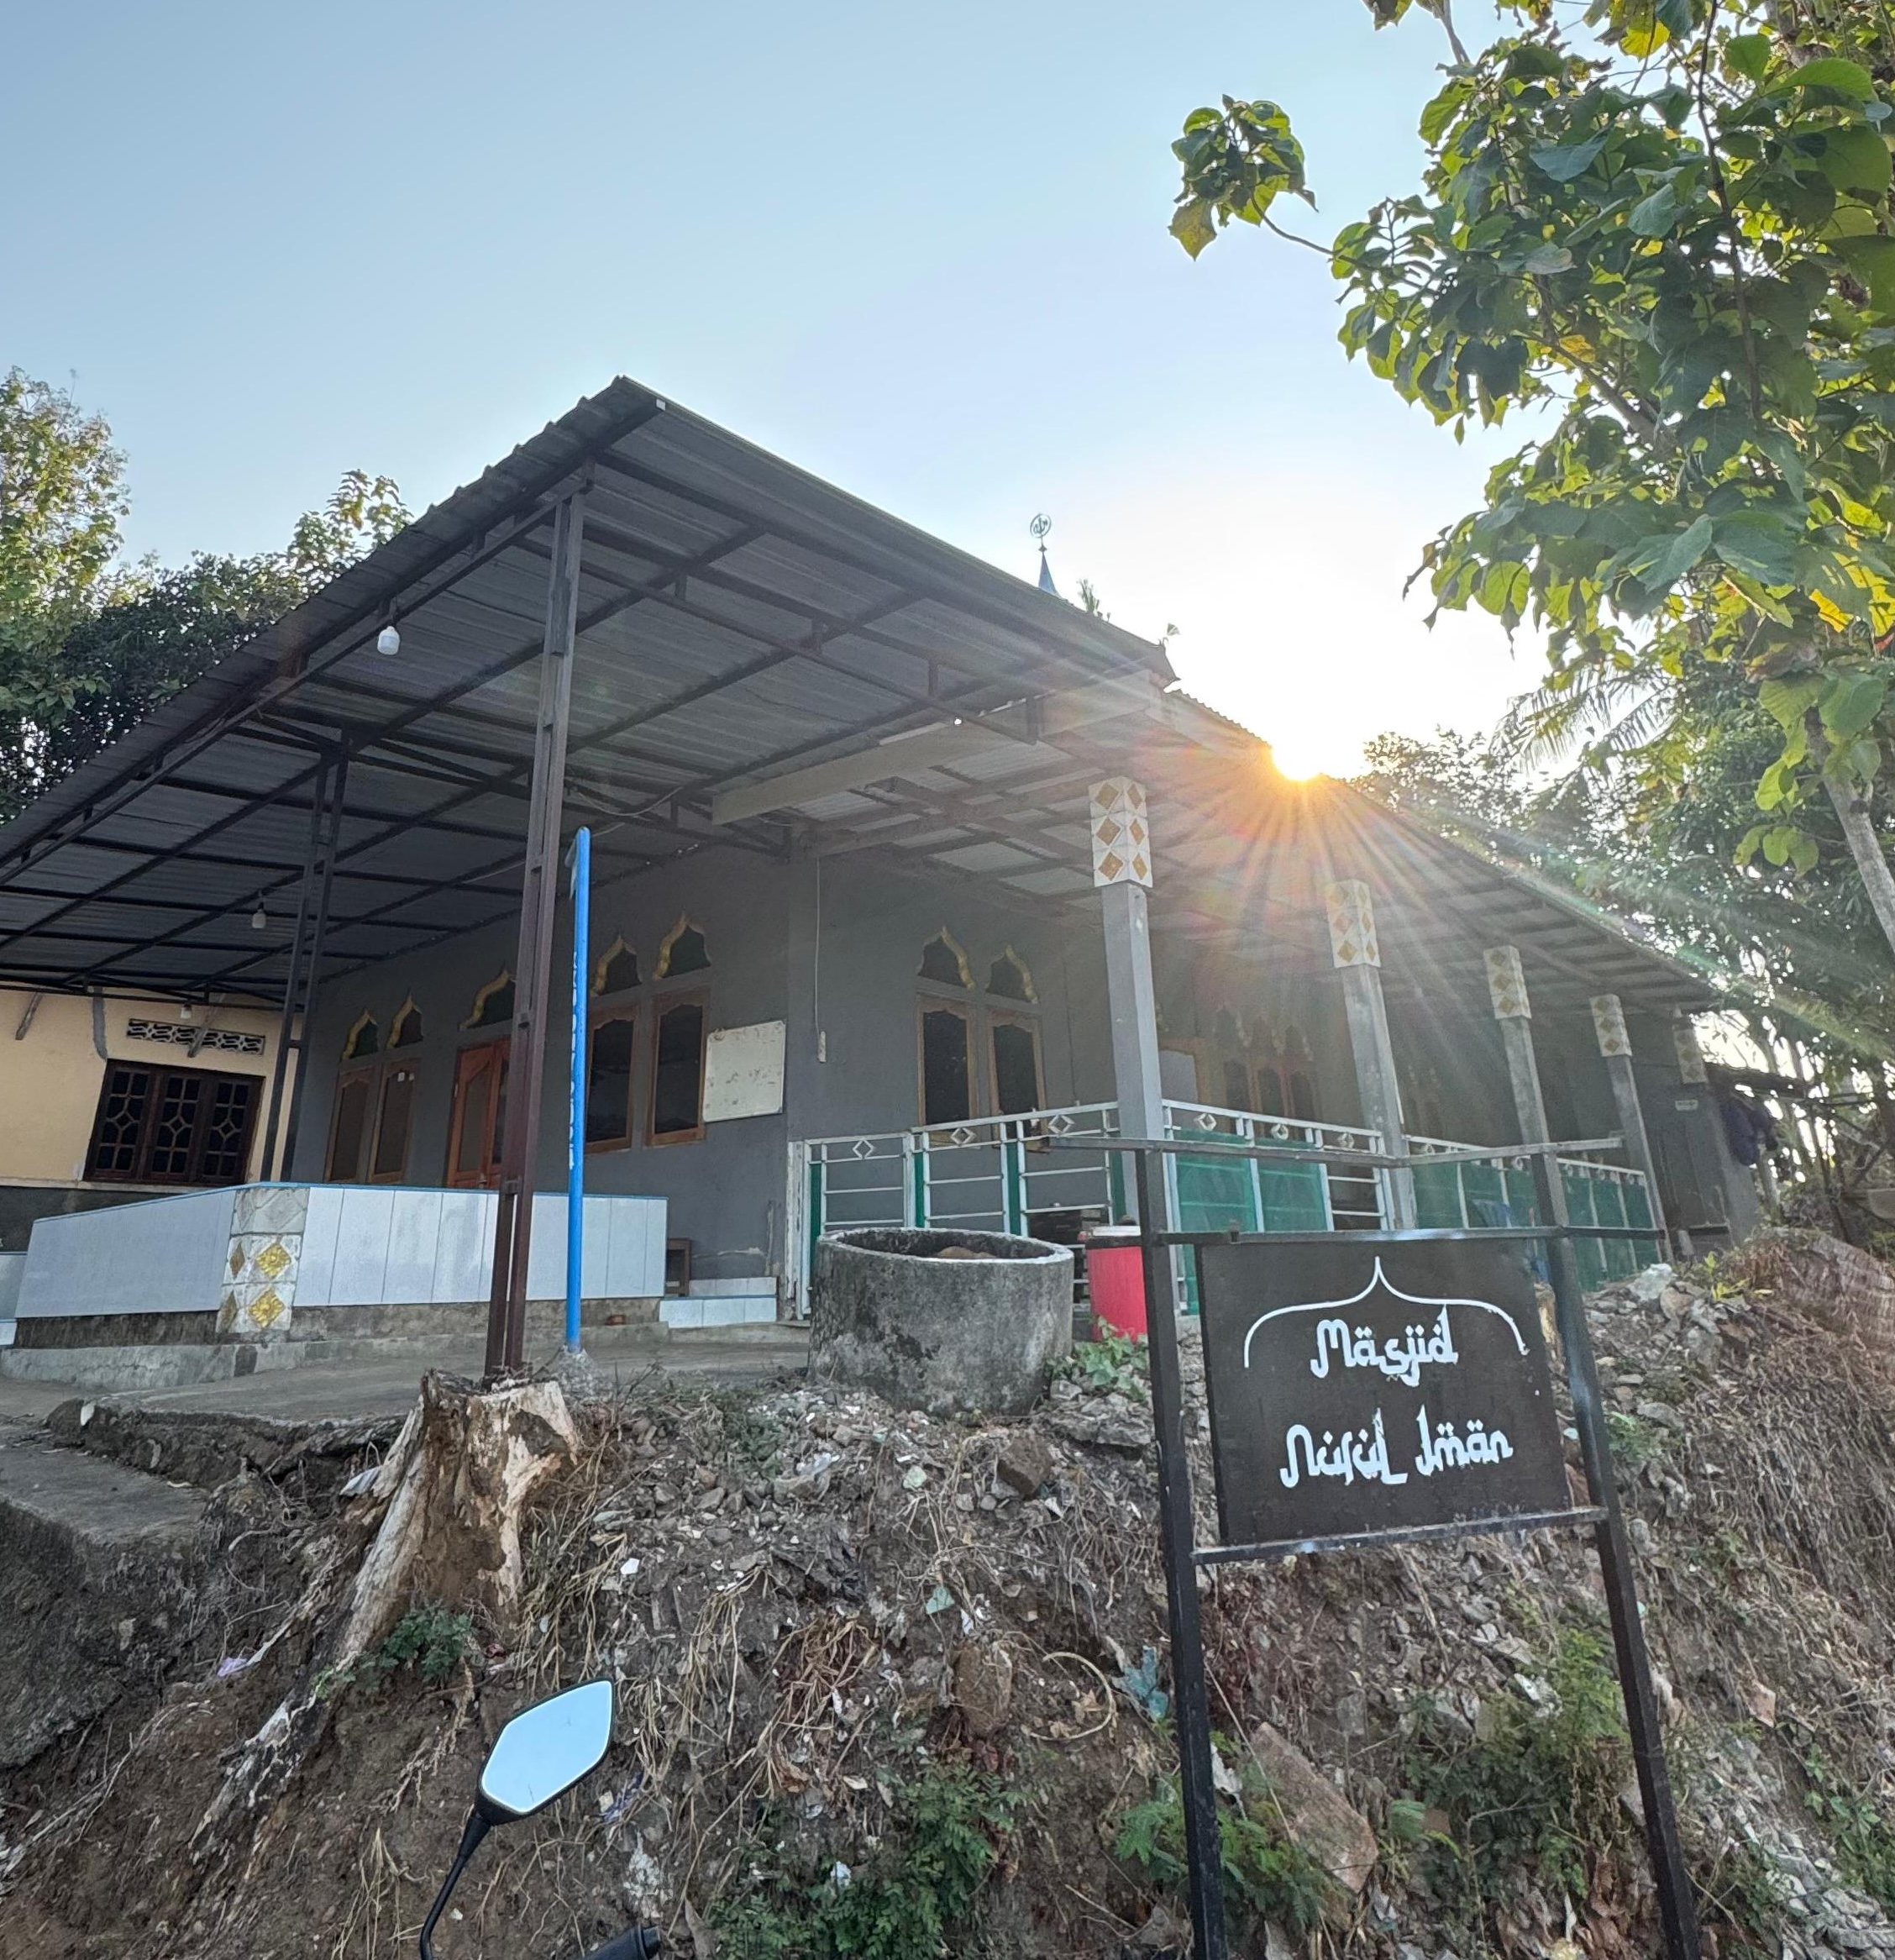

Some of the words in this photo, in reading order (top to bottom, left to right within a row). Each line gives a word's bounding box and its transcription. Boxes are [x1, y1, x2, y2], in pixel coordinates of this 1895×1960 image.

[1310, 1304, 1458, 1387] Masjid
[1280, 1408, 1408, 1488] Nurul
[1415, 1404, 1513, 1476] Iman
